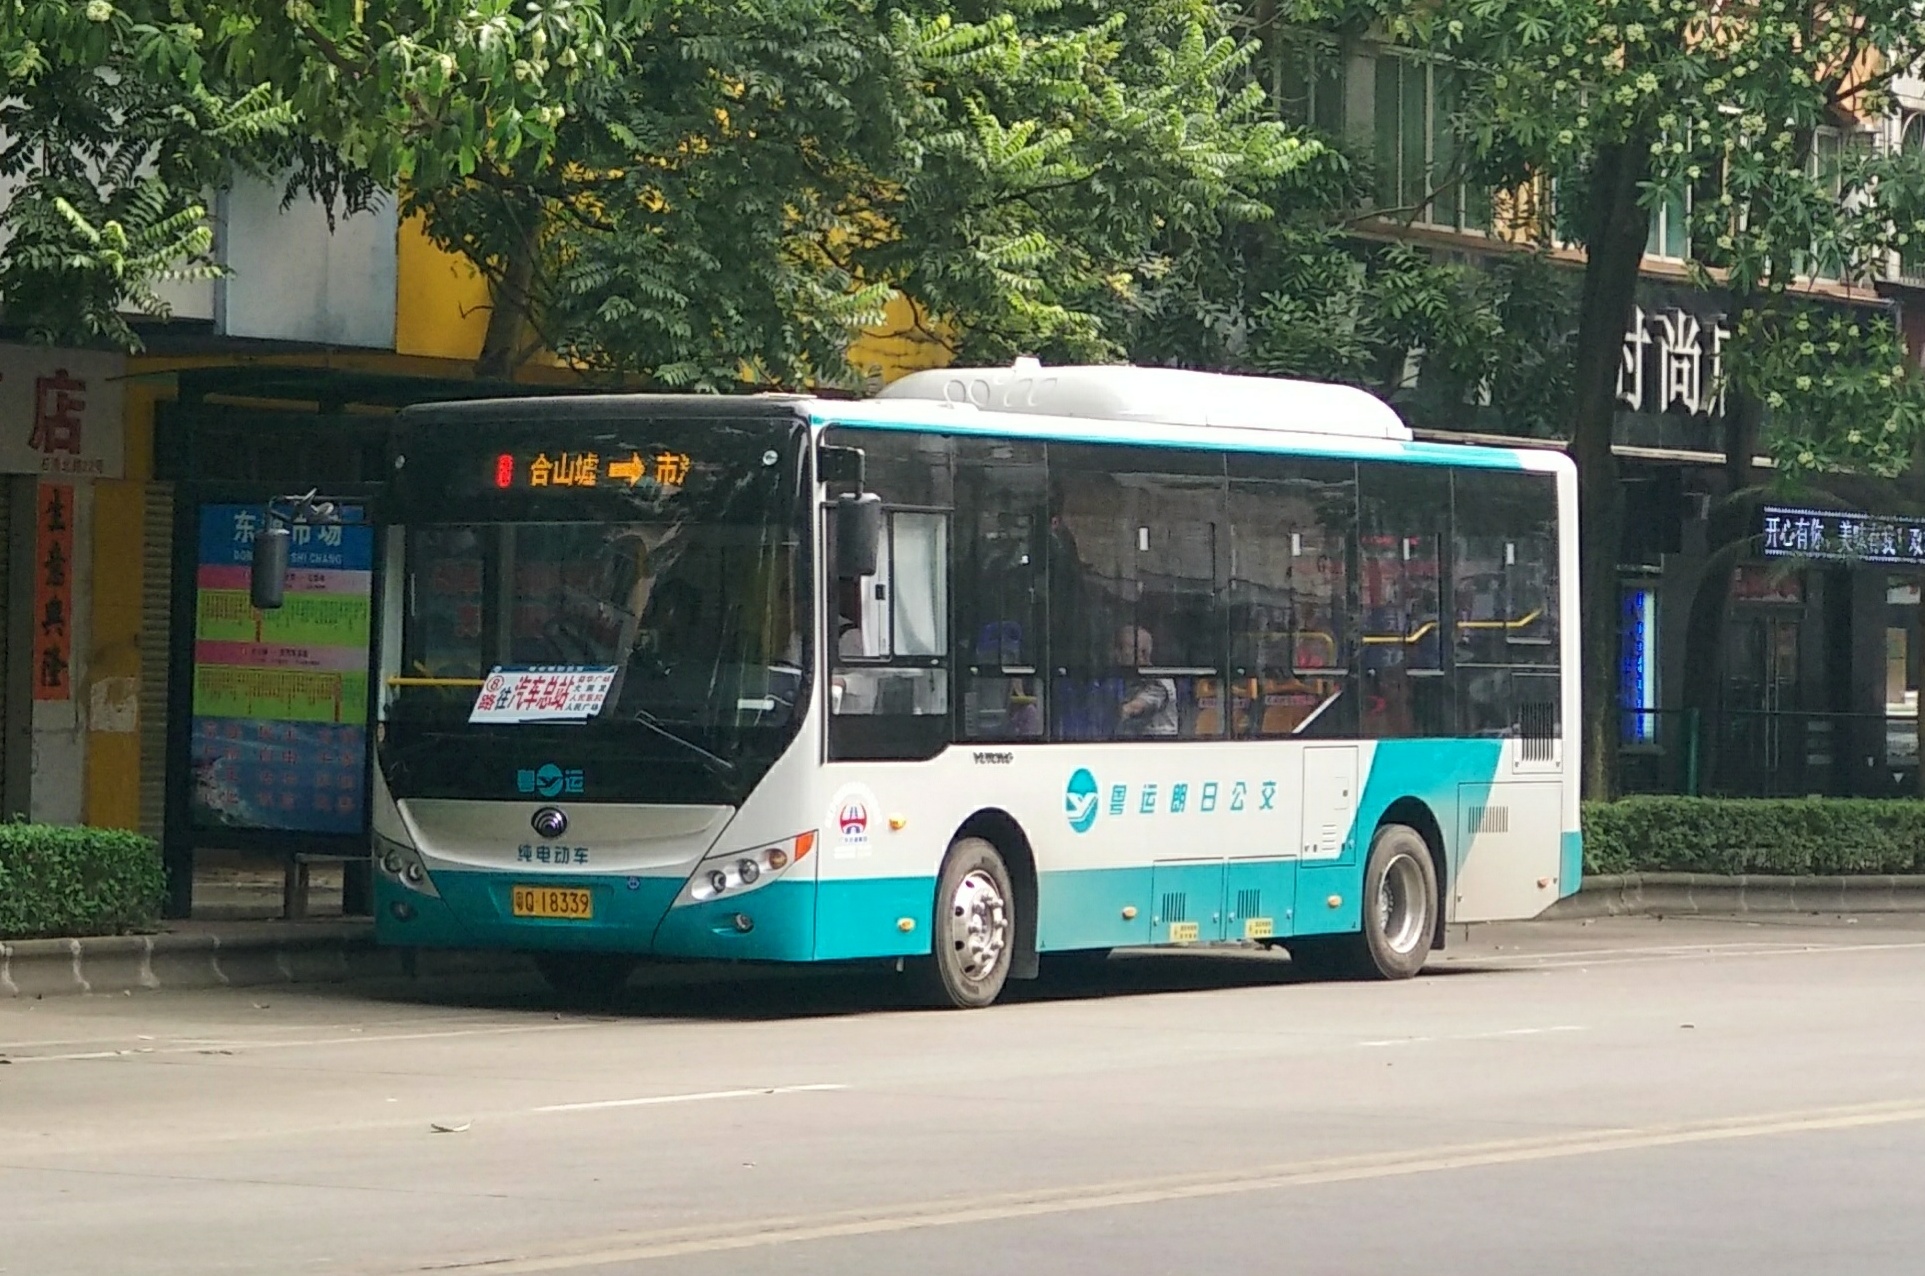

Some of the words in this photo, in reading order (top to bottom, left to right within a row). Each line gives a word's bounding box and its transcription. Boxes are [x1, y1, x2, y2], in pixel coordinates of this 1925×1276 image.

[28, 368, 87, 455] 店
[531, 452, 599, 486] 合山墟
[517, 844, 588, 865] 纯电动车
